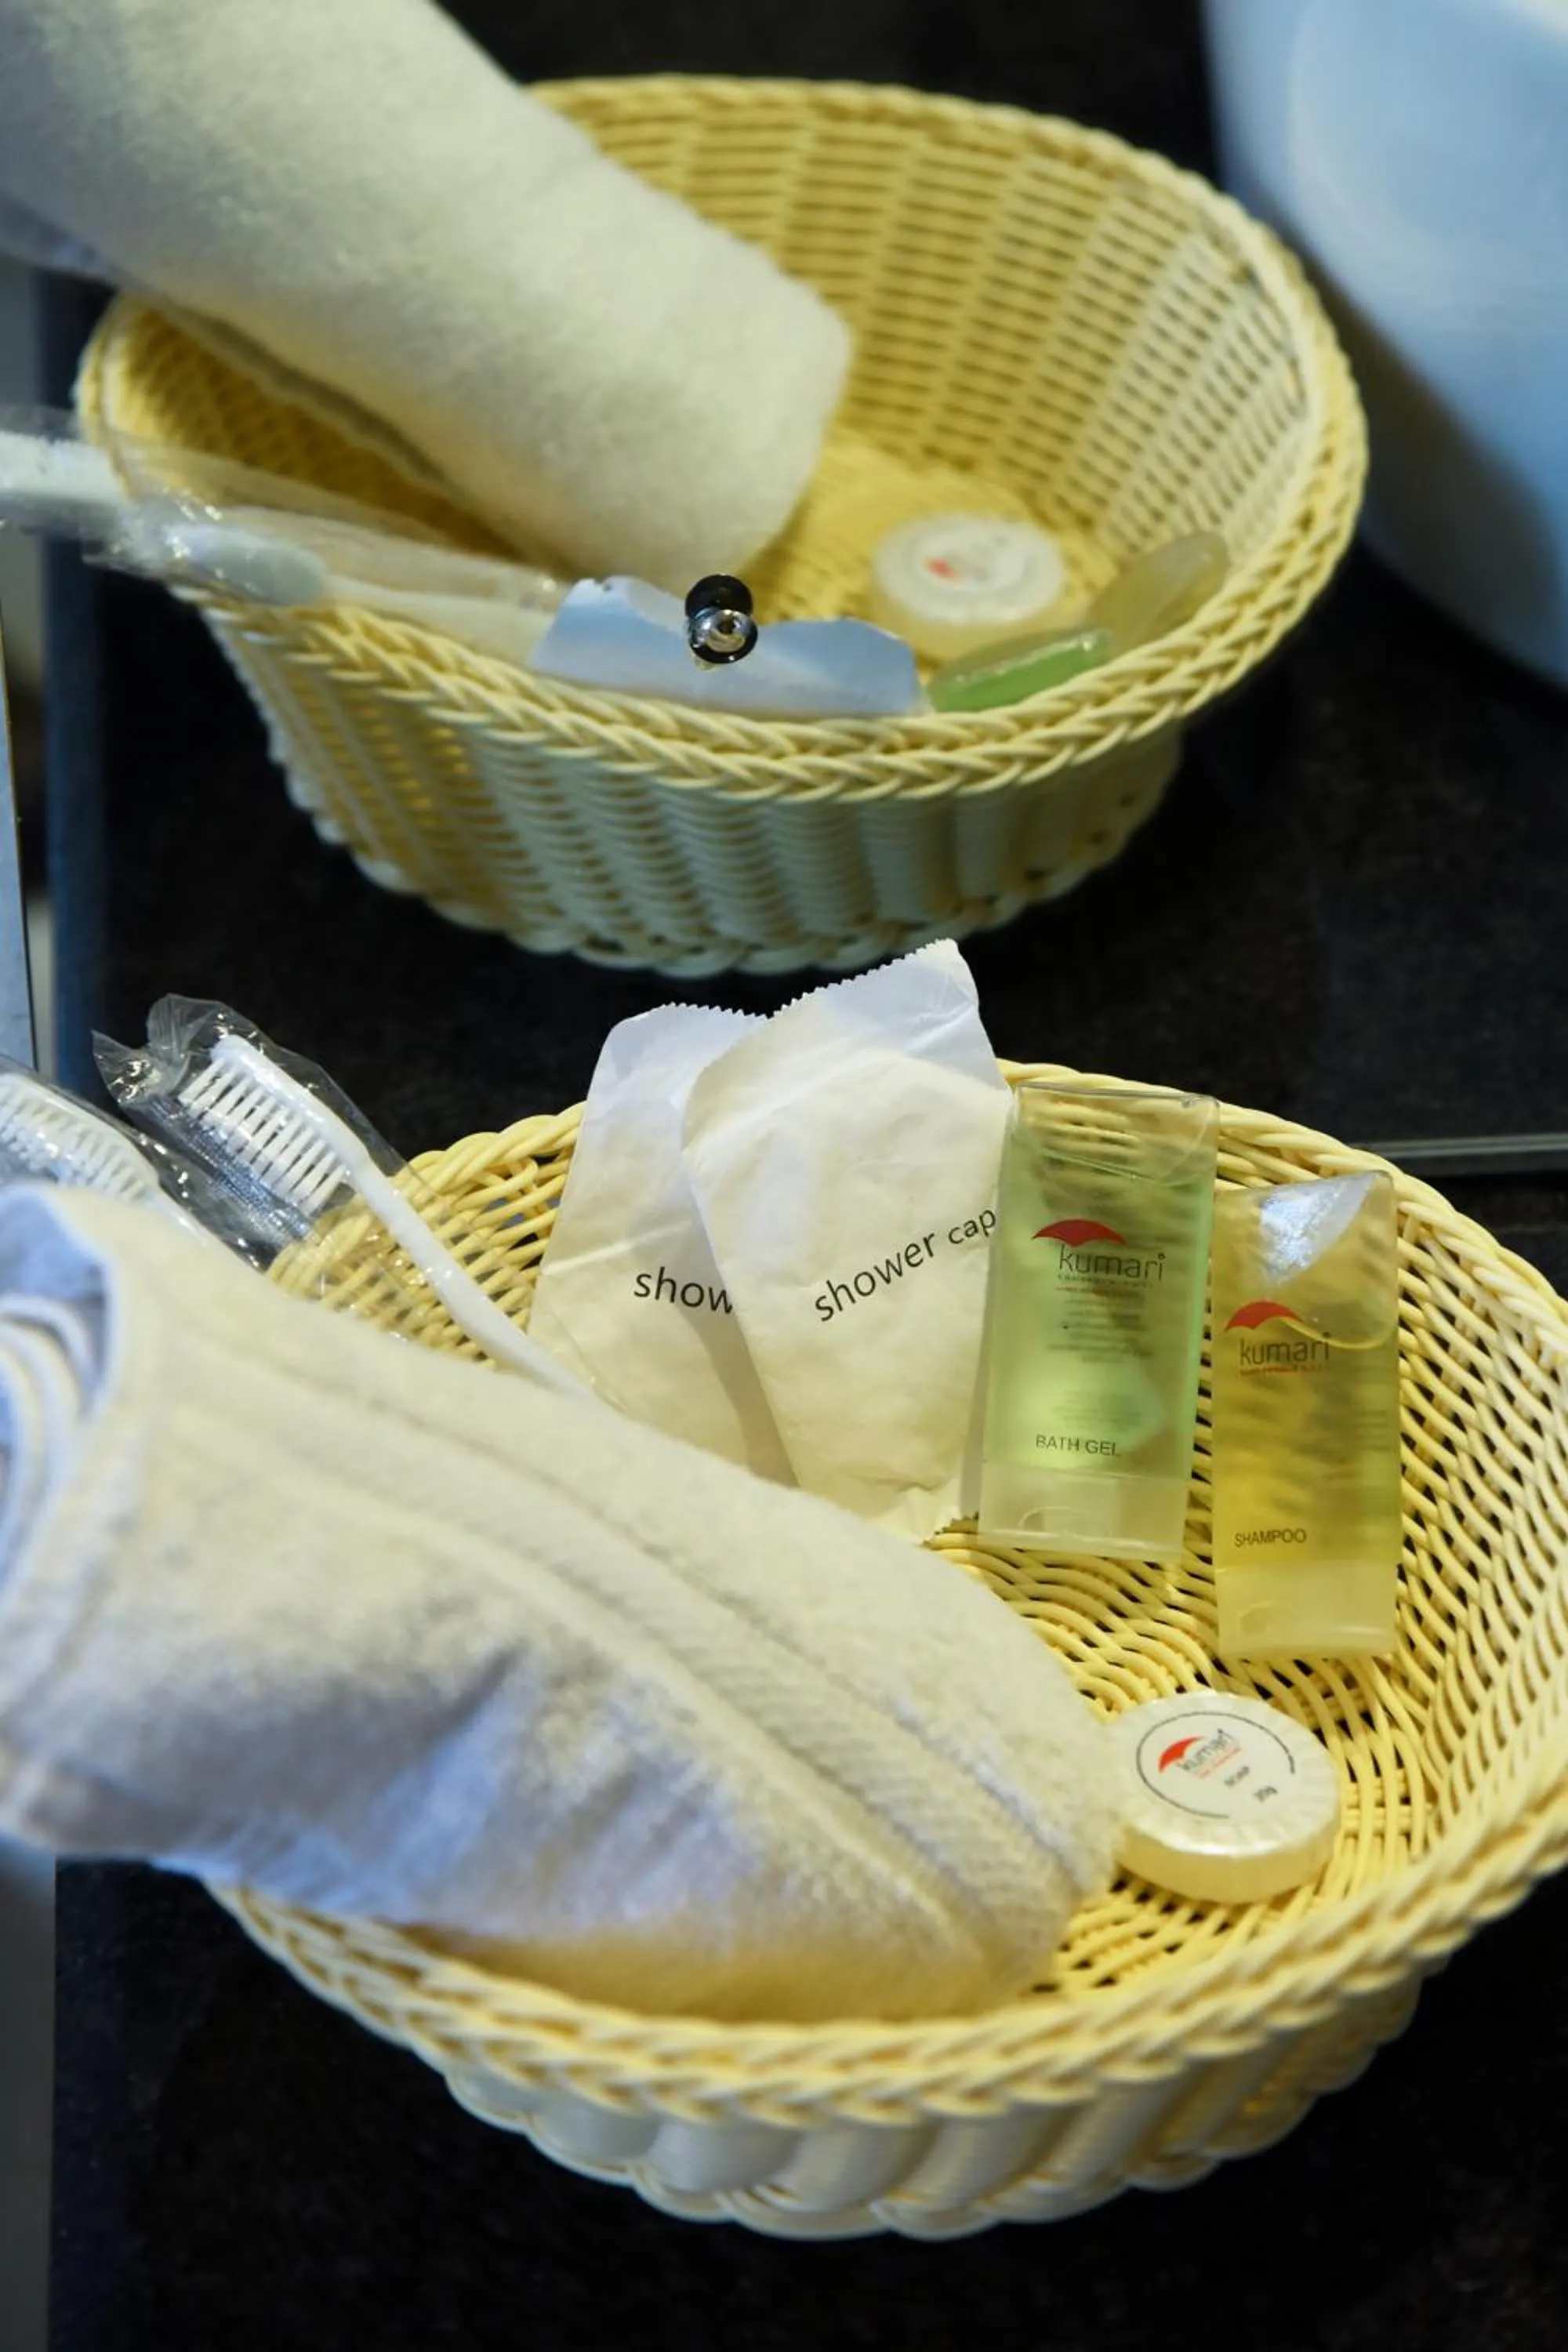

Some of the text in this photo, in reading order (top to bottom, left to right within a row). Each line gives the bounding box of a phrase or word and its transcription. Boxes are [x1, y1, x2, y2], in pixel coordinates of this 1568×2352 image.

[814, 1208, 997, 1323] shower cap
[1058, 1244, 1166, 1282] kumari
[1240, 1331, 1331, 1366] kumari
[1035, 1433, 1123, 1458] BATH GEL
[1233, 1528, 1308, 1548] SHAMPOO
